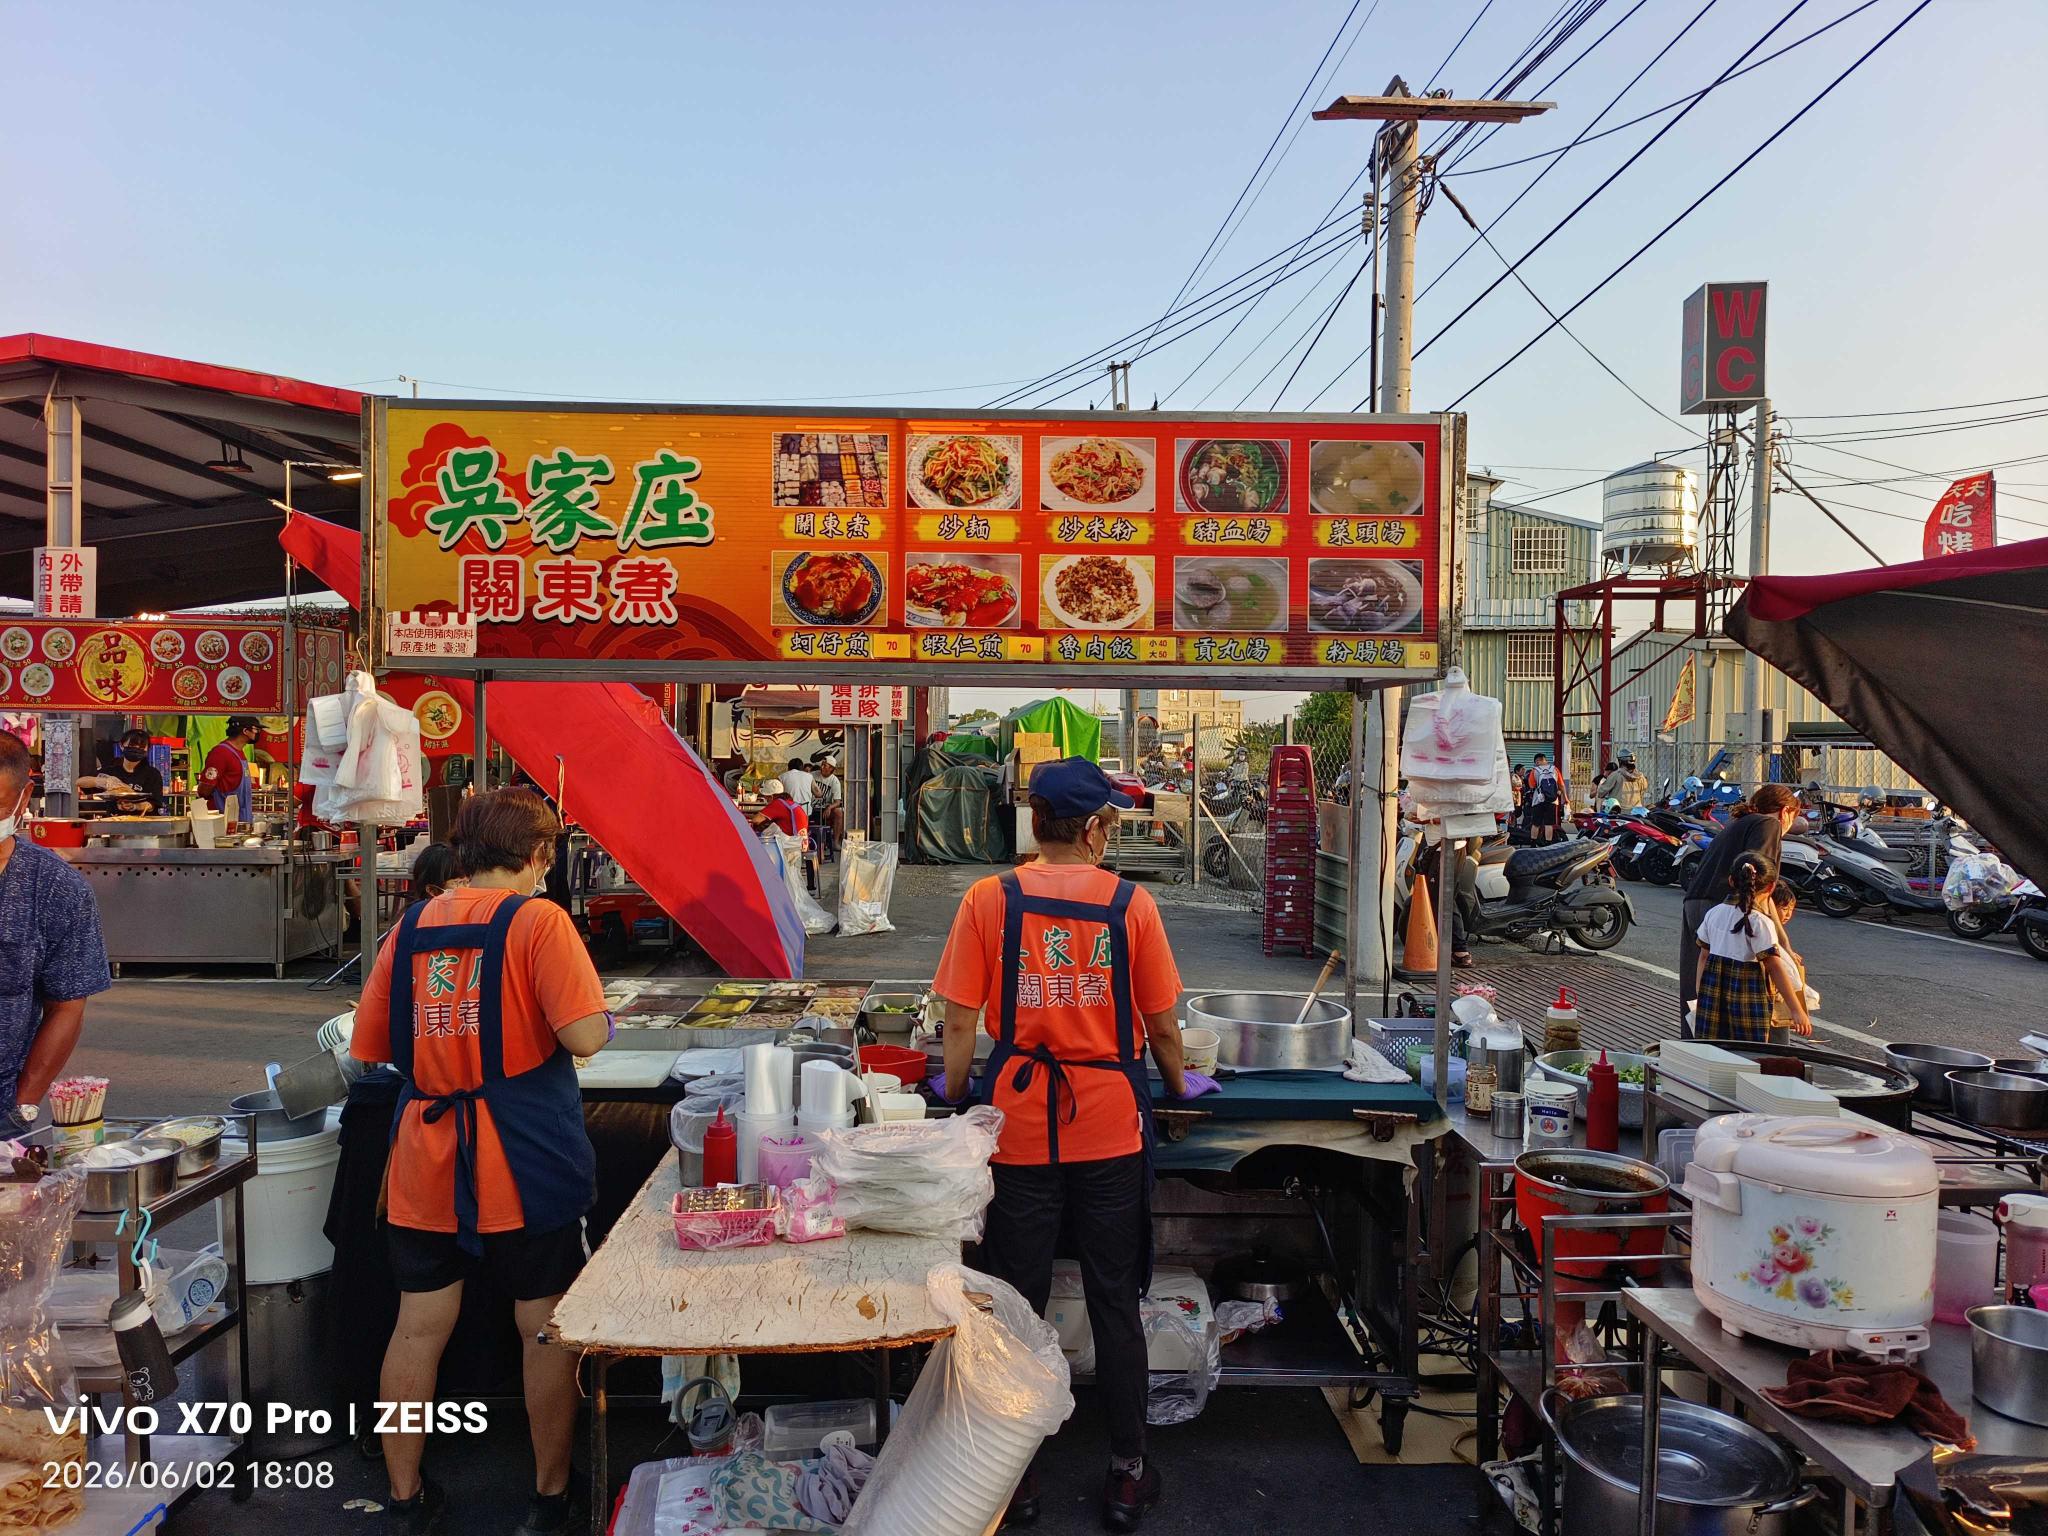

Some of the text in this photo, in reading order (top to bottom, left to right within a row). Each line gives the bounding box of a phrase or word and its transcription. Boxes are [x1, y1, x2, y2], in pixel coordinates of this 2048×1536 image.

[1712, 289, 1762, 393] WC
[426, 446, 715, 552] 吳家庄
[1943, 480, 1986, 498] 天天
[794, 512, 870, 539] 關東煮
[938, 515, 991, 541] 炒麵
[1058, 516, 1138, 542] 炒米粉
[1193, 518, 1271, 543] 豬血湯
[1327, 520, 1406, 546] 菜頭湯
[60, 552, 83, 618] 外帶請
[459, 554, 679, 625] 關東煮
[393, 628, 474, 640] 本店使用豬肉原料
[400, 641, 437, 653] 原產地
[791, 632, 898, 658] 蚵仔煎 70
[922, 635, 1032, 659] 蝦仁煎 70
[1149, 639, 1168, 648] 小 40
[1058, 636, 1137, 661] 魯肉飯
[1149, 650, 1168, 659] 大 50
[1194, 638, 1269, 663] 貢丸湯
[1327, 640, 1431, 664] 粉腸湯 50
[96, 633, 129, 703] 品味
[1016, 973, 1108, 1008] 關東煮
